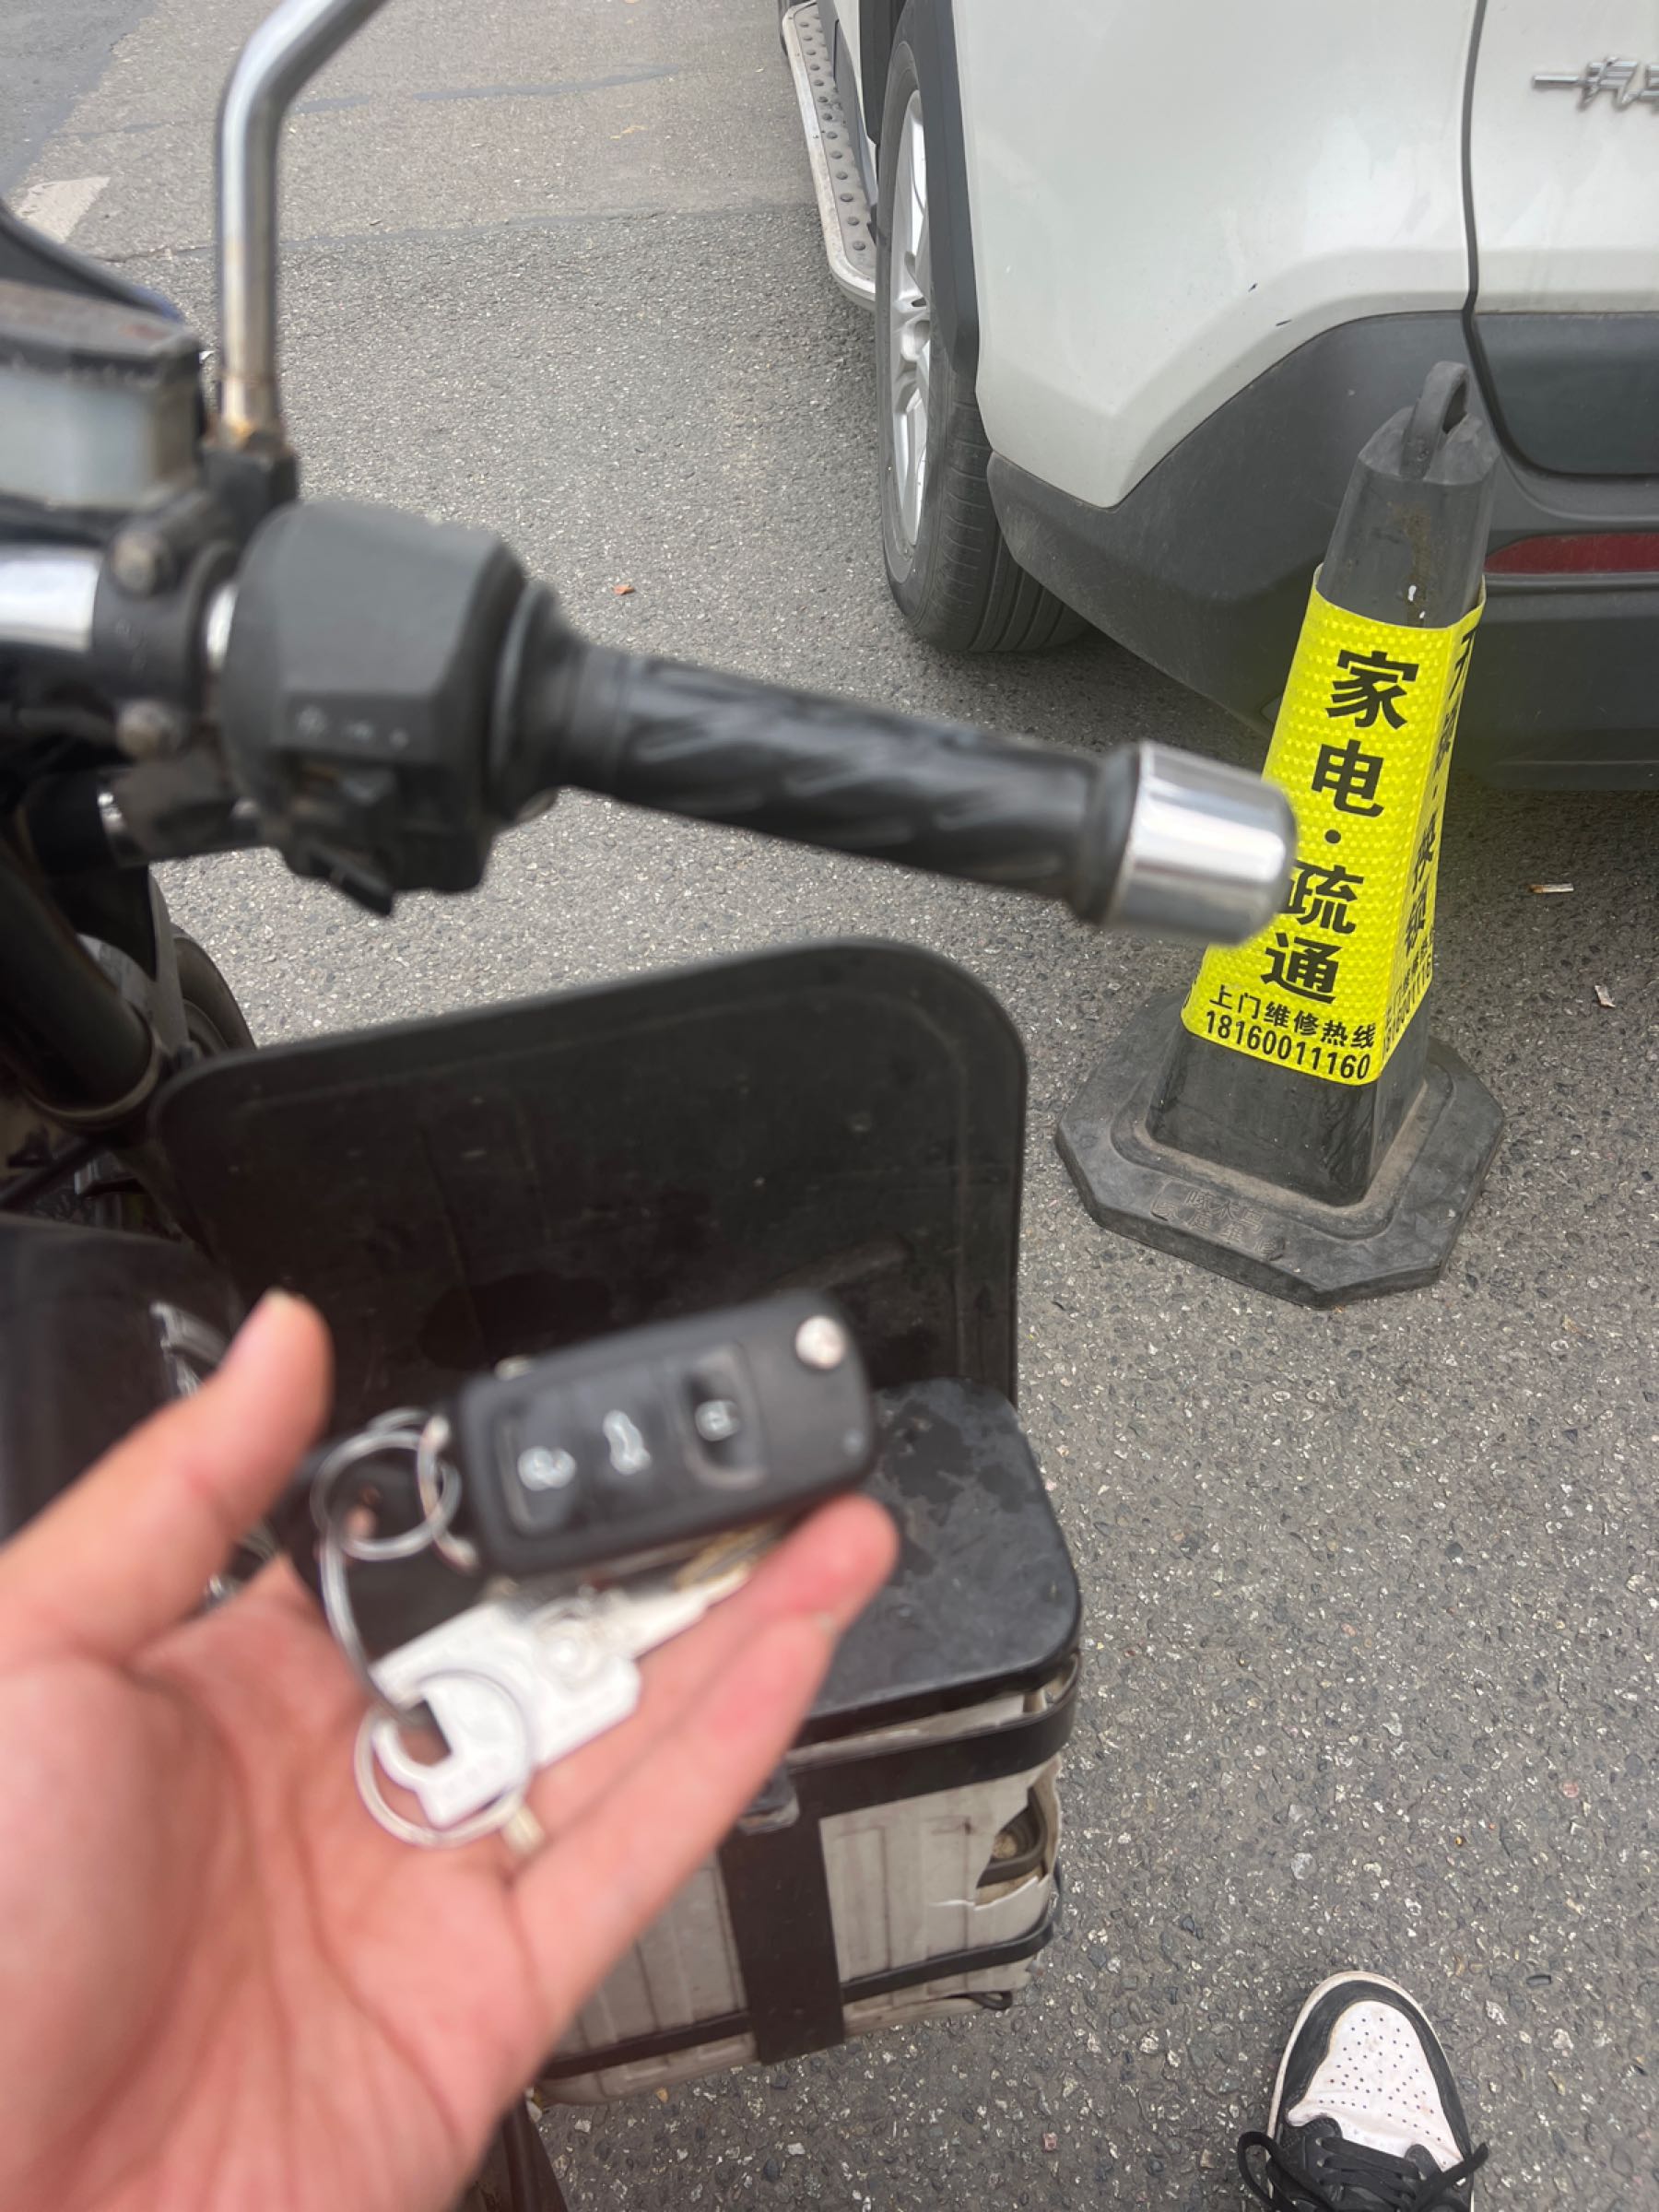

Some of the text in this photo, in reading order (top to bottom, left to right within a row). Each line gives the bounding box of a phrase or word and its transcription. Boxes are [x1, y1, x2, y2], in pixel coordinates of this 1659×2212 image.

[1206, 1010, 1371, 1079] 18160011160
[1209, 983, 1376, 1049] 上门维修热线
